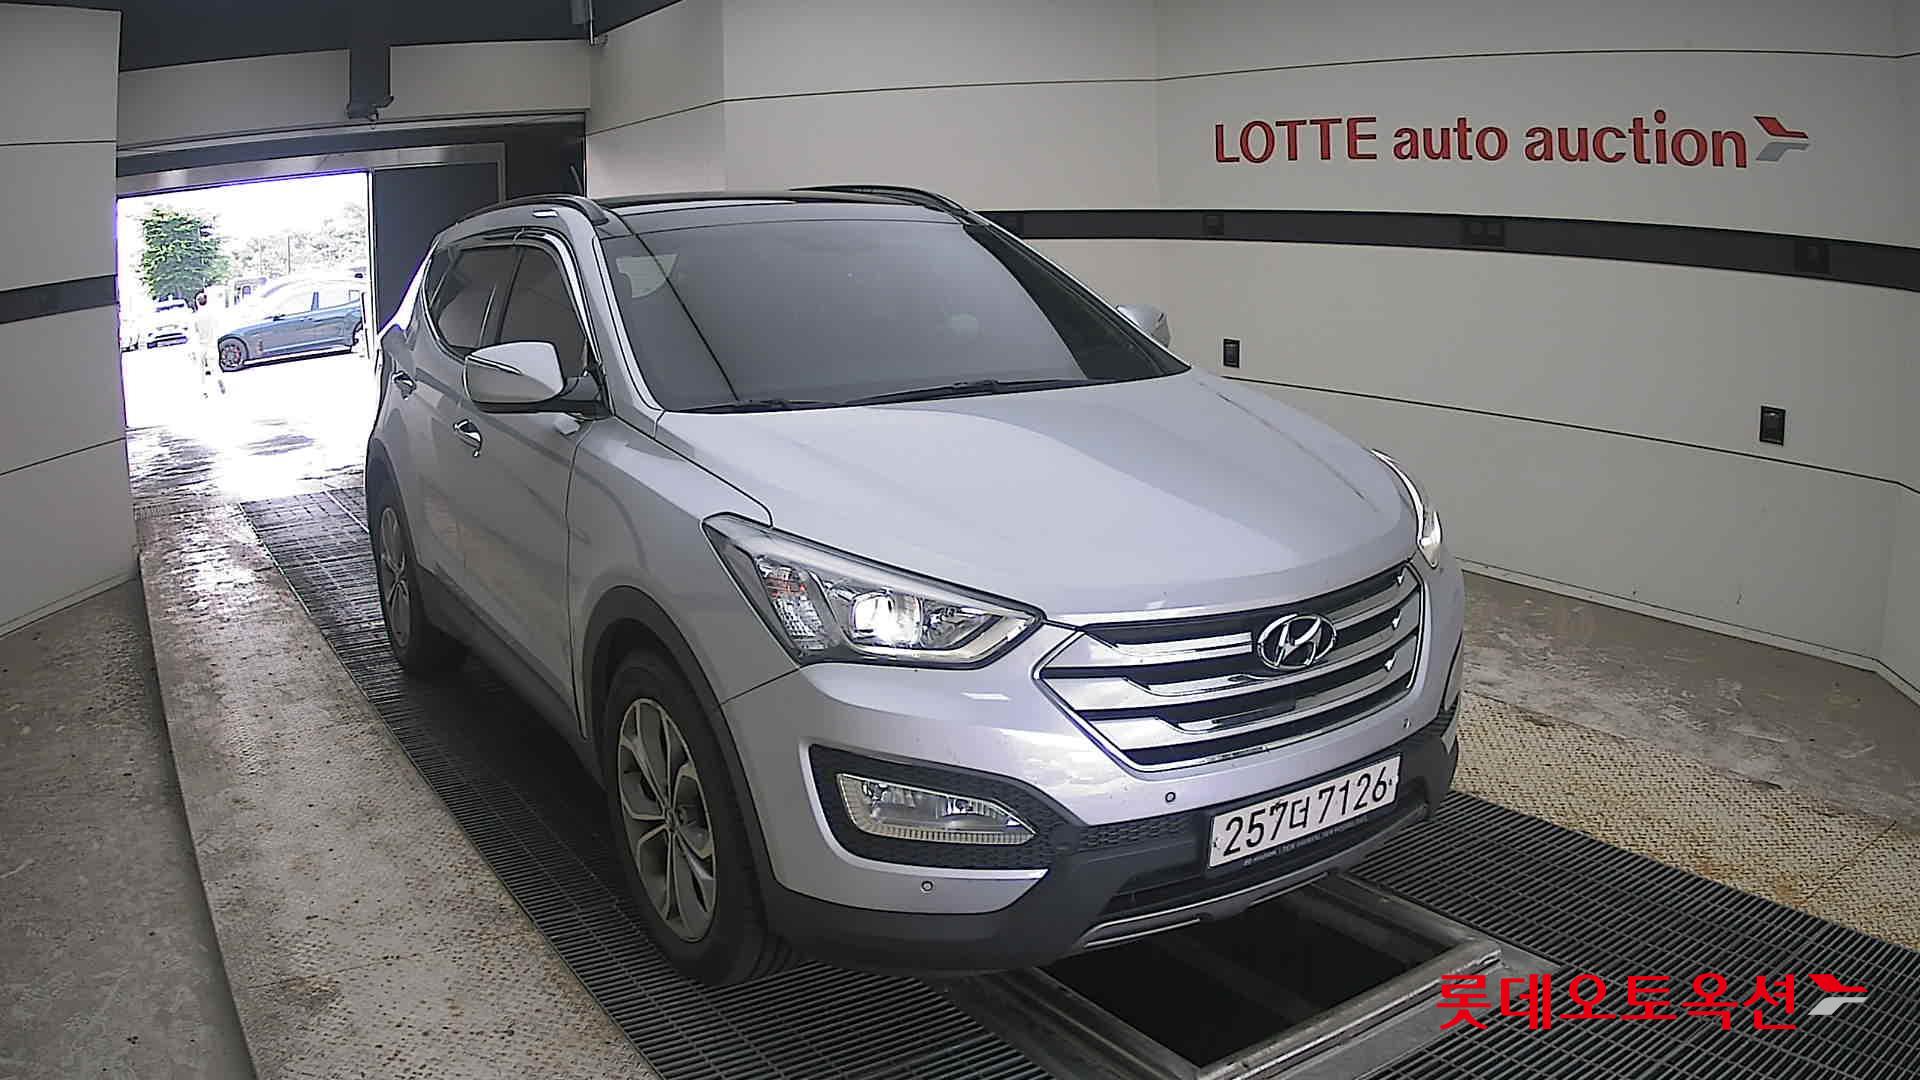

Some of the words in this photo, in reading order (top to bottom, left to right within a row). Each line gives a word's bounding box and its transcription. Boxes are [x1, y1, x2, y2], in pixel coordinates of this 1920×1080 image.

[1214, 116, 1378, 164] LOTTE
[1392, 116, 1509, 161] auto
[1525, 109, 1748, 169] auction
[1223, 796, 1311, 856] 257더
[1318, 766, 1388, 824] 7126
